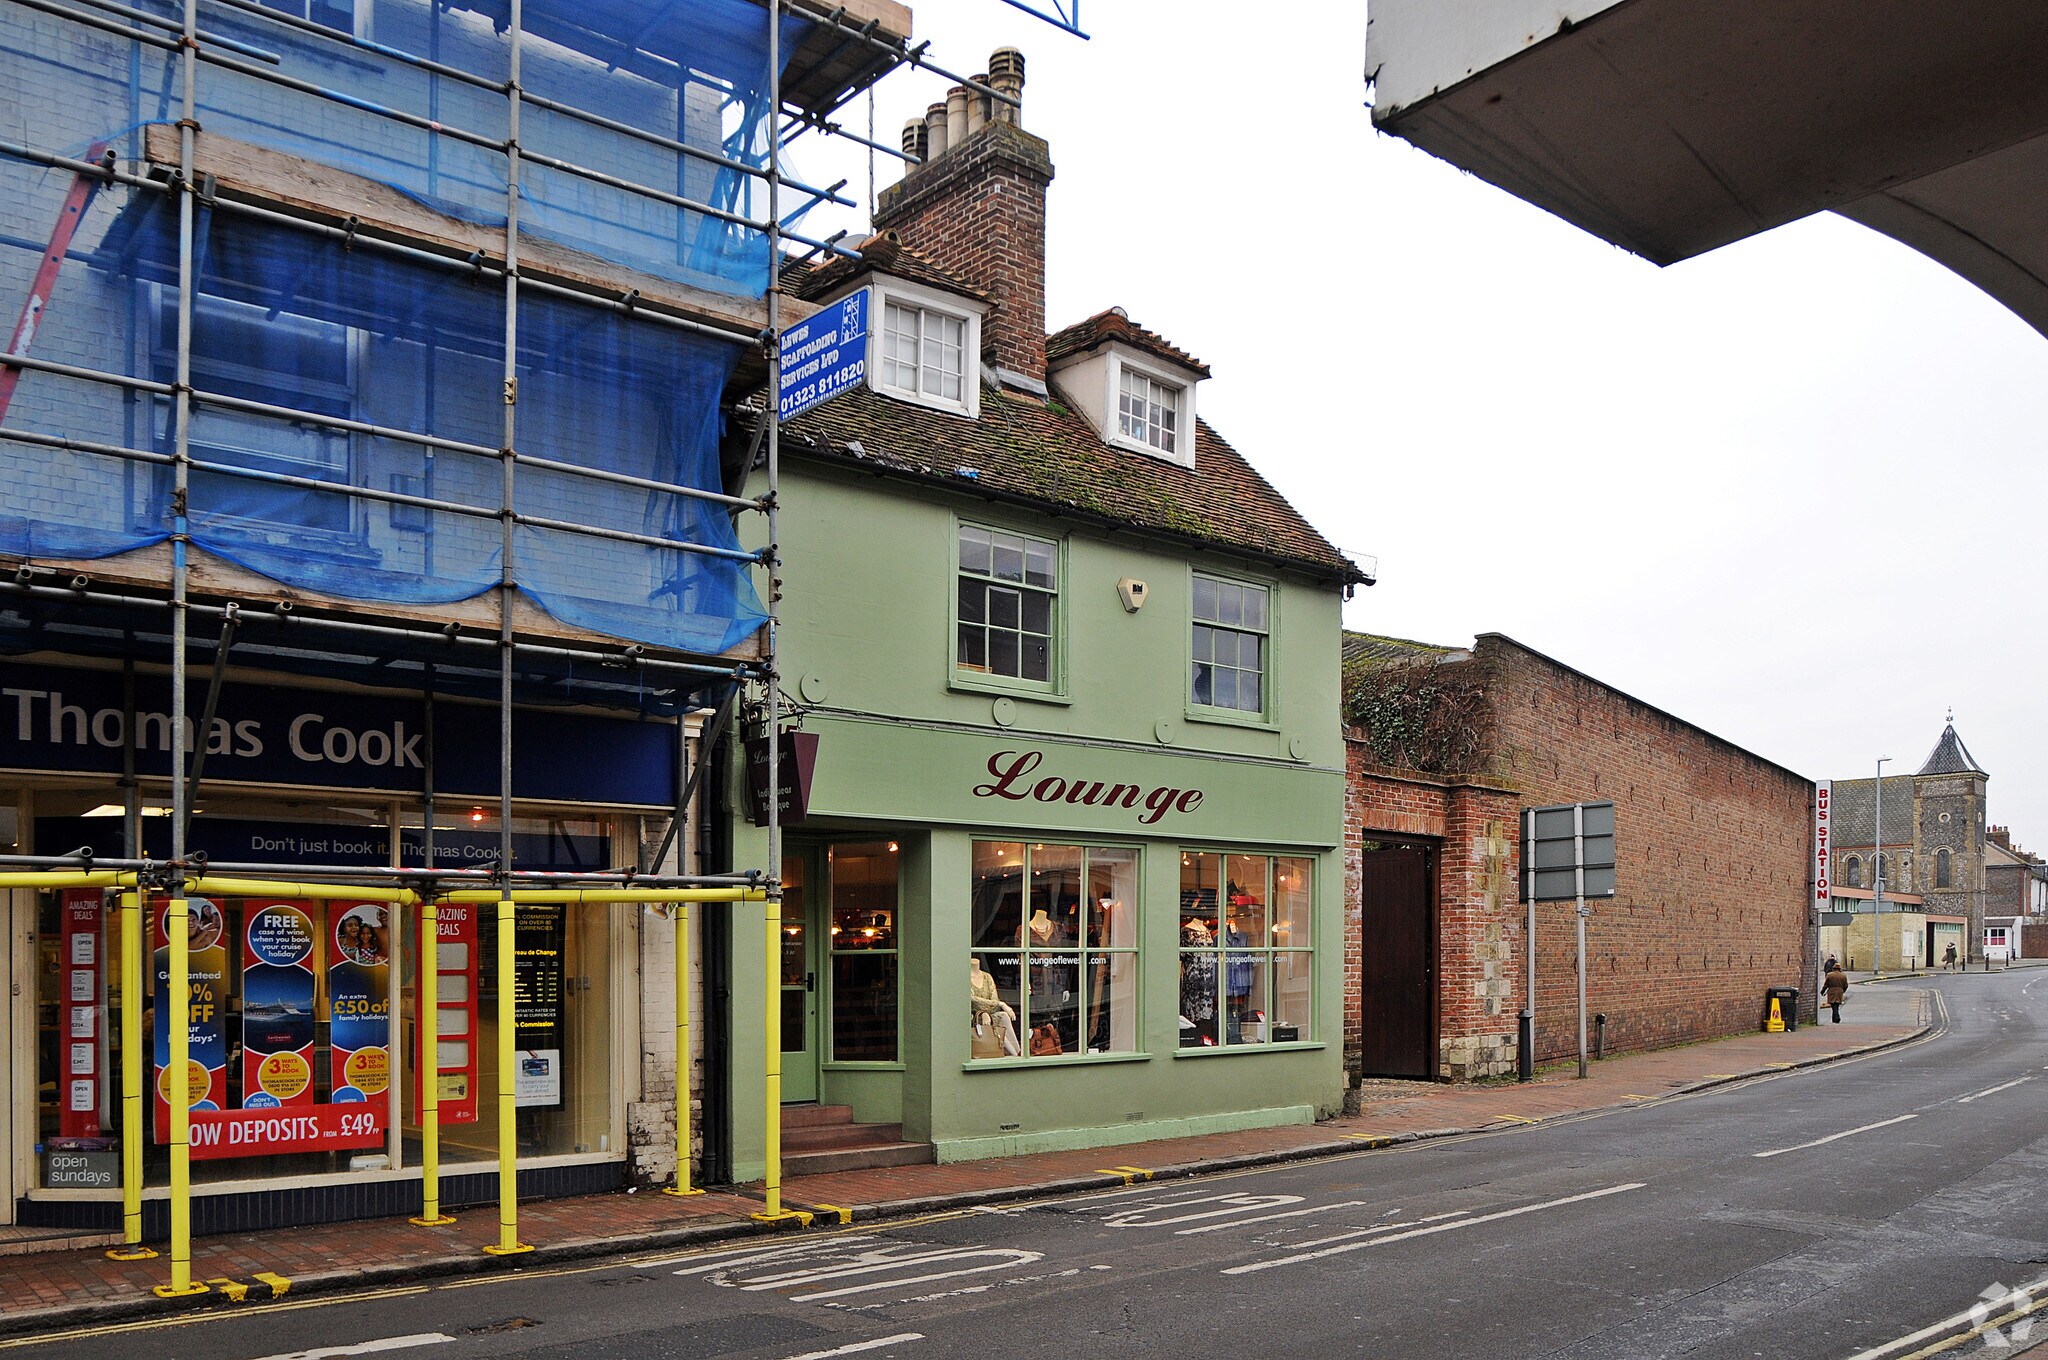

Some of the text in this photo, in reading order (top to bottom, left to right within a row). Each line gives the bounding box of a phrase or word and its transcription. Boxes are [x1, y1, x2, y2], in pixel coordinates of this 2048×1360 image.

[781, 325, 809, 351] LEWES
[781, 330, 837, 370] SCAFFOLDING
[781, 349, 839, 390] SERVICES LTD
[781, 360, 864, 412] 01323 811820
[3, 688, 425, 768] Thomas Cook
[753, 751, 787, 764] Louge
[972, 750, 1204, 824] Lounge
[251, 836, 295, 851] Don't
[299, 838, 328, 854] just
[333, 839, 373, 854] book
[463, 845, 502, 859] Cook
[1817, 789, 1828, 899] BUS STATION
[69, 901, 98, 910] AMAZING
[74, 911, 93, 920] DEALS
[264, 915, 299, 928] FREE
[436, 908, 467, 921] MAZING
[188, 1004, 214, 1022] FF
[334, 1000, 369, 1014] £50
[269, 1059, 281, 1074] 3
[356, 1054, 367, 1070] 3
[189, 1123, 222, 1147] OW
[229, 1117, 319, 1144] DEPOSITS
[323, 1130, 337, 1138] FROM
[52, 1157, 87, 1170] open
[51, 1171, 111, 1185] sundays
